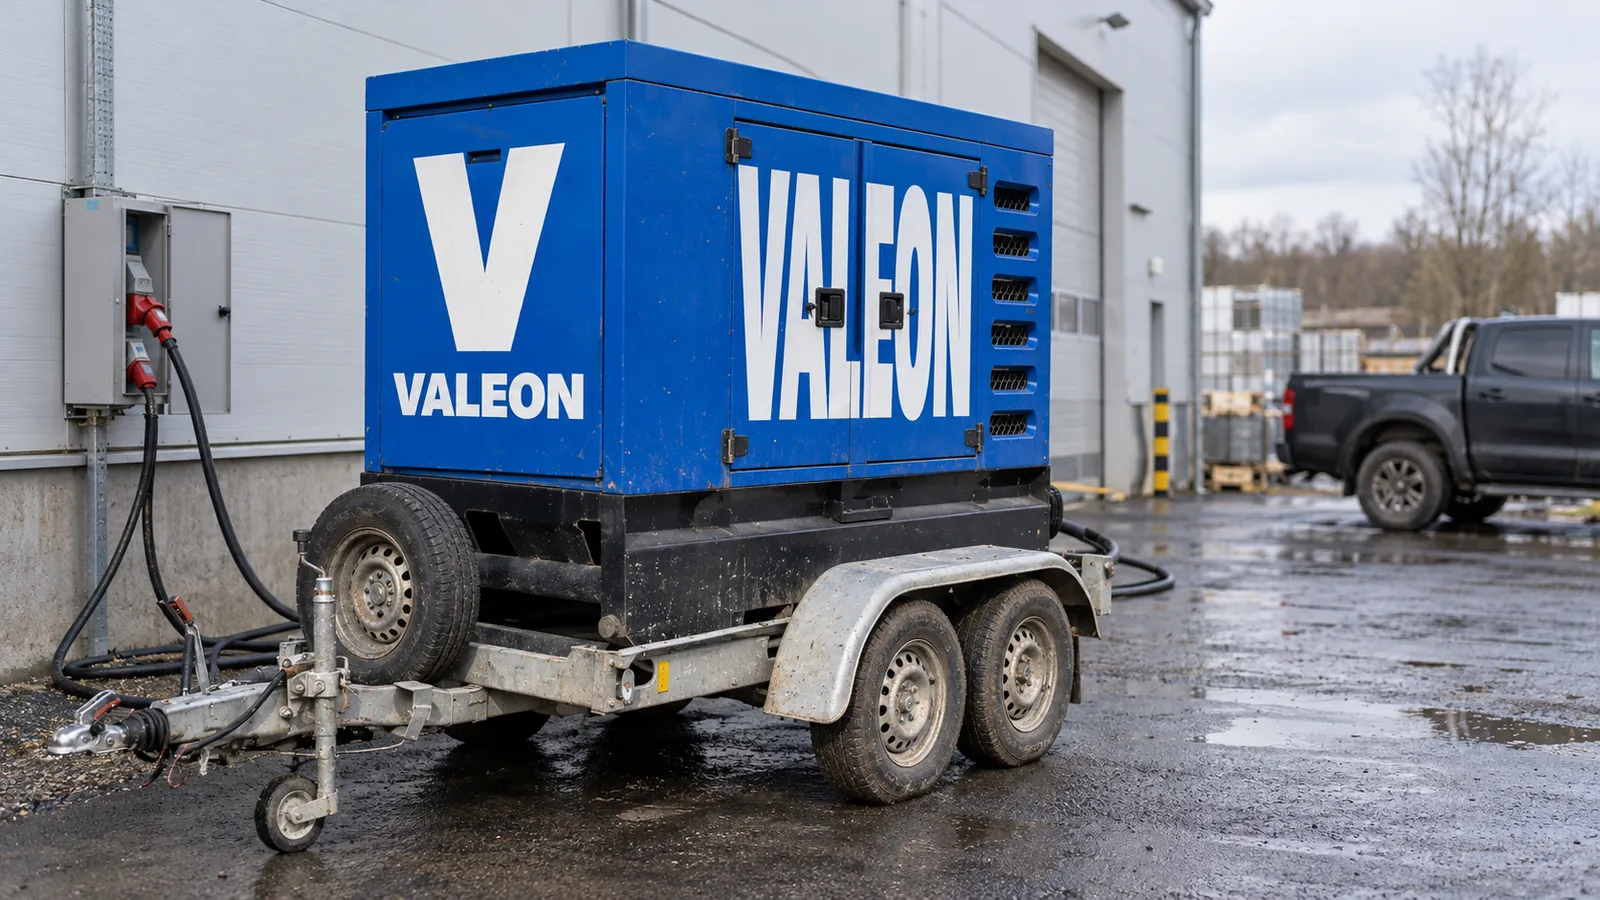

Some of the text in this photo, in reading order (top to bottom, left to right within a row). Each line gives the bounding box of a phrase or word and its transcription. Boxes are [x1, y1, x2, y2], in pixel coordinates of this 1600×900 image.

[413, 142, 565, 352] V
[738, 164, 973, 421] VALEON
[393, 372, 584, 420] VALEON
